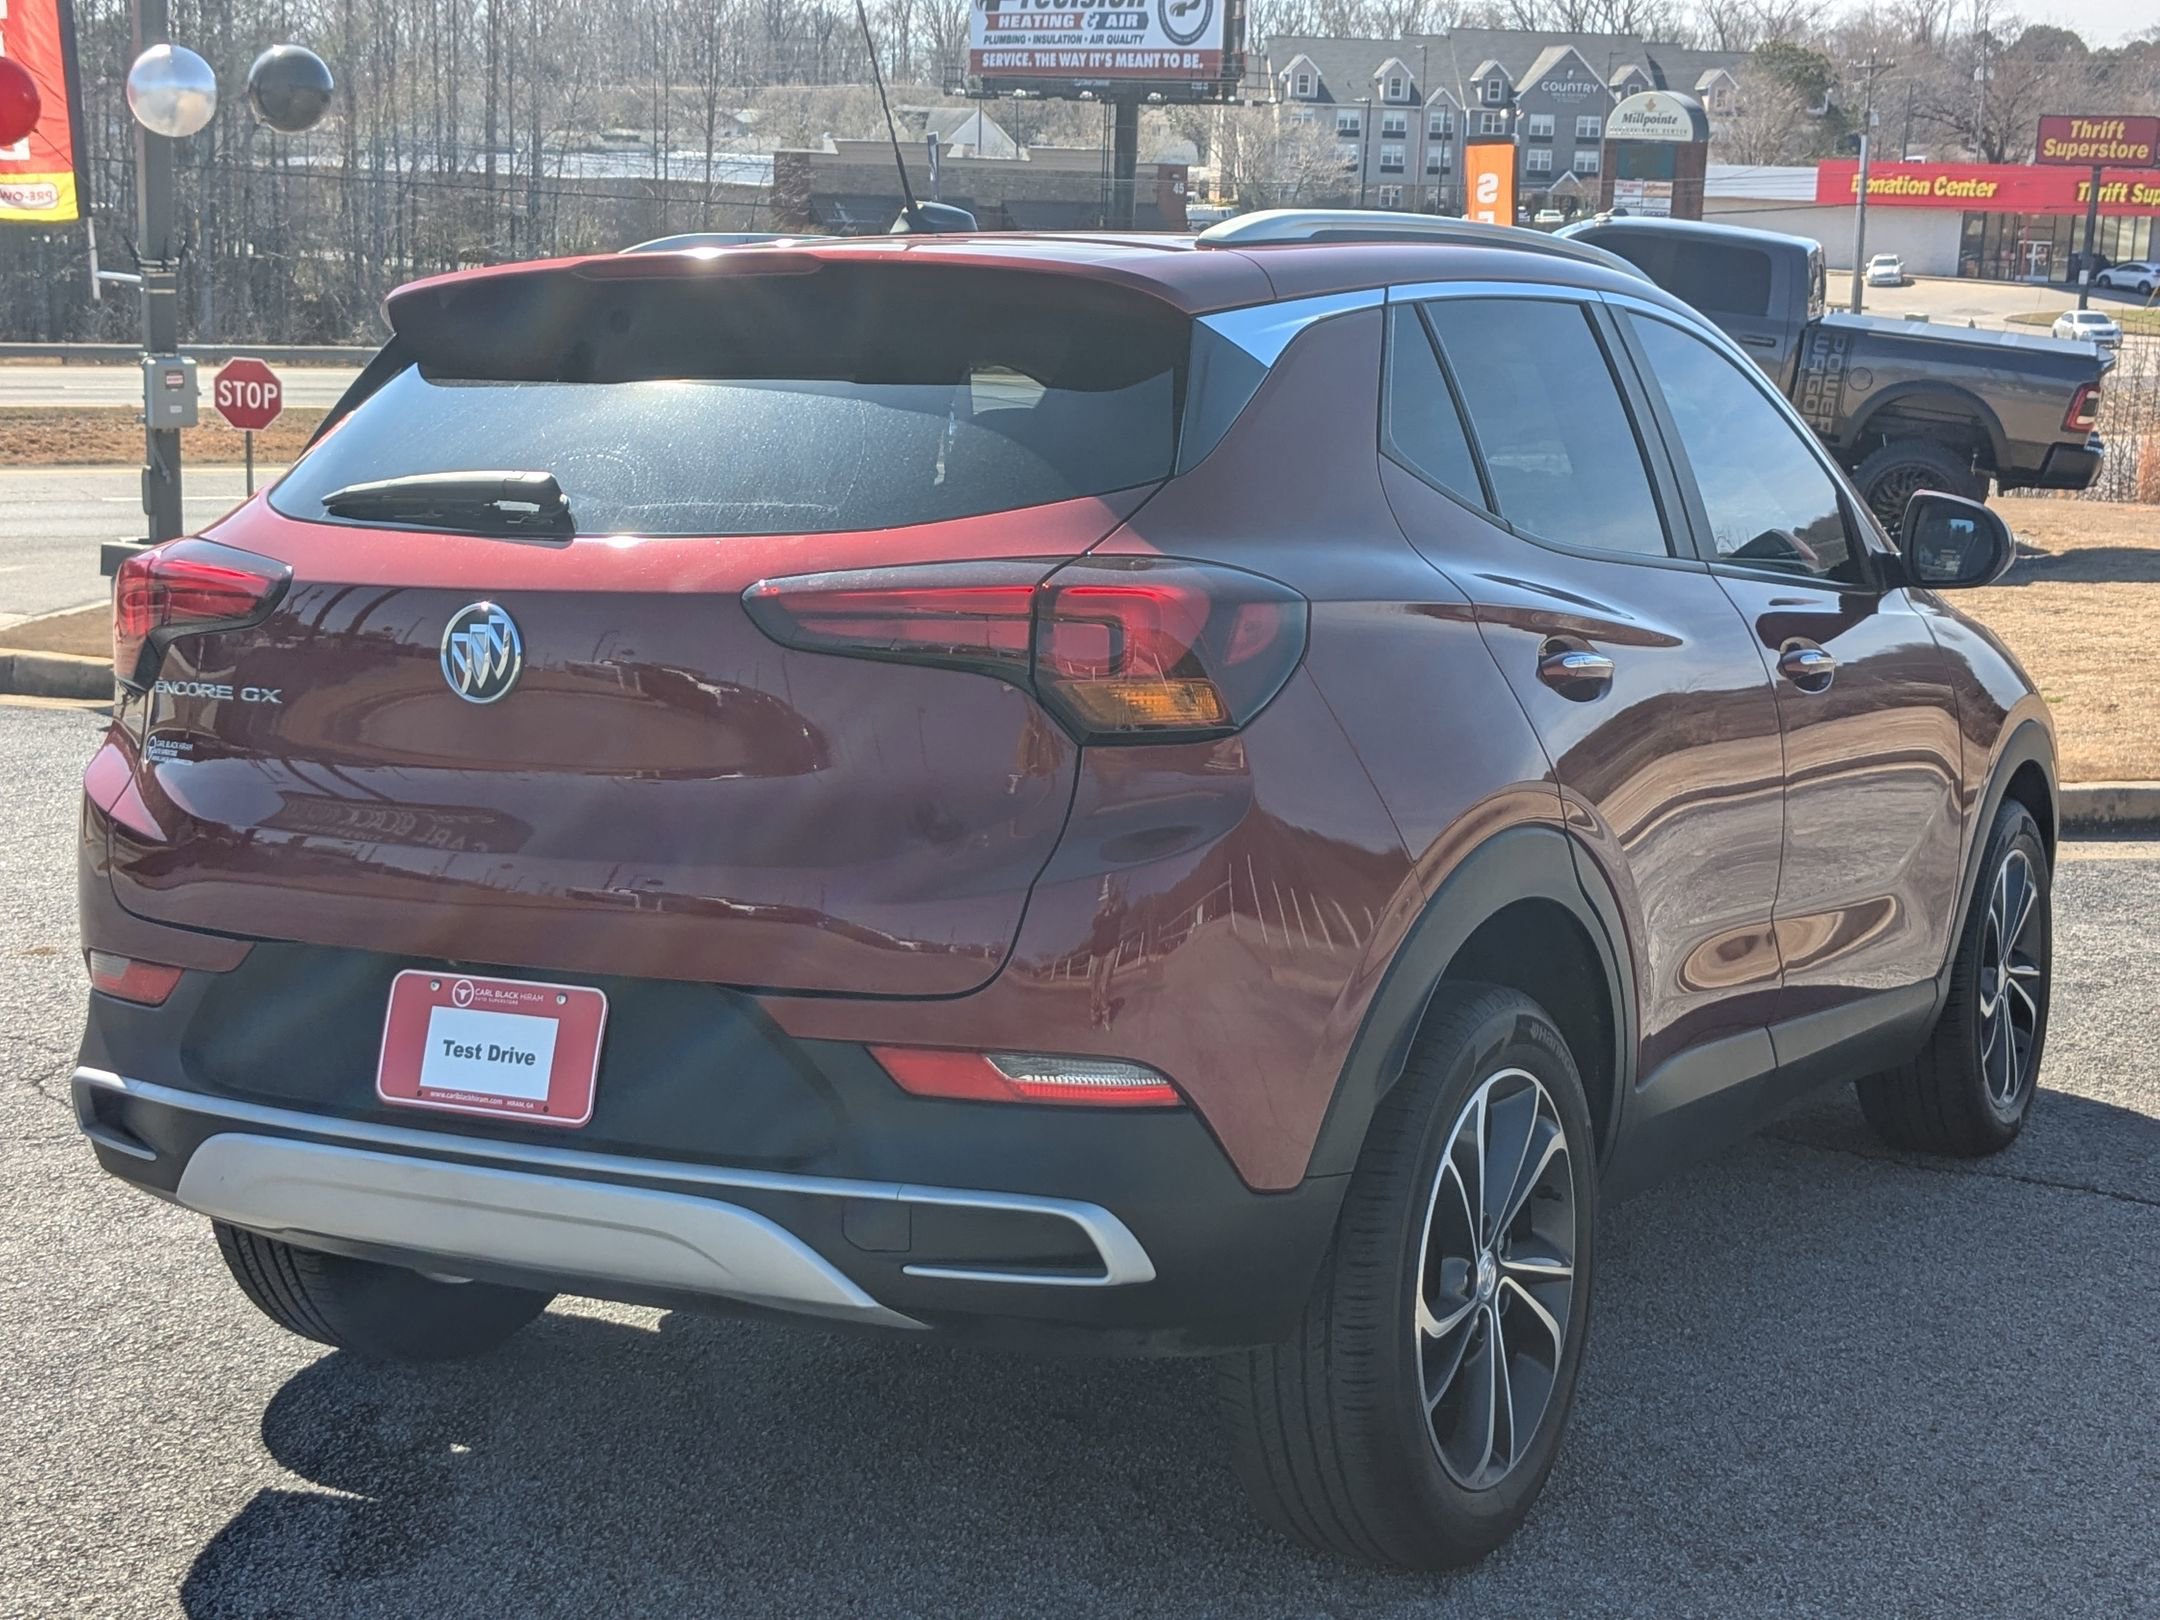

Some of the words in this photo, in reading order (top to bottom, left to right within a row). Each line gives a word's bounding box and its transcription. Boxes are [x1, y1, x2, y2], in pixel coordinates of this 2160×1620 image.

[997, 14, 1075, 28] HEATING
[1105, 14, 1139, 28] AIR
[984, 34, 1026, 45] PLUMBING
[1033, 34, 1082, 45] INSULATION
[1089, 34, 1104, 45] AIR
[1107, 34, 1145, 45] QUALITY
[982, 52, 1032, 68] SERVICE.
[1035, 53, 1056, 67] THE
[1058, 53, 1087, 67] WAY
[1089, 53, 1112, 68] IT'S
[1115, 53, 1161, 68] MEANT
[1163, 53, 1180, 68] TO
[1183, 53, 1204, 68] BE.
[1541, 81, 1599, 94] COUNTRY
[1621, 112, 1678, 127] Millpointe
[2071, 120, 2126, 140] Thrift
[2043, 138, 2149, 161] Superstore
[1934, 176, 1998, 198] Center
[219, 380, 278, 409] STOP
[155, 680, 234, 701] ENCORE
[240, 687, 283, 704] GX
[475, 988, 493, 997] CARL
[495, 990, 519, 999] BLACK
[443, 1039, 482, 1060] Test
[487, 1044, 536, 1066] Drive
